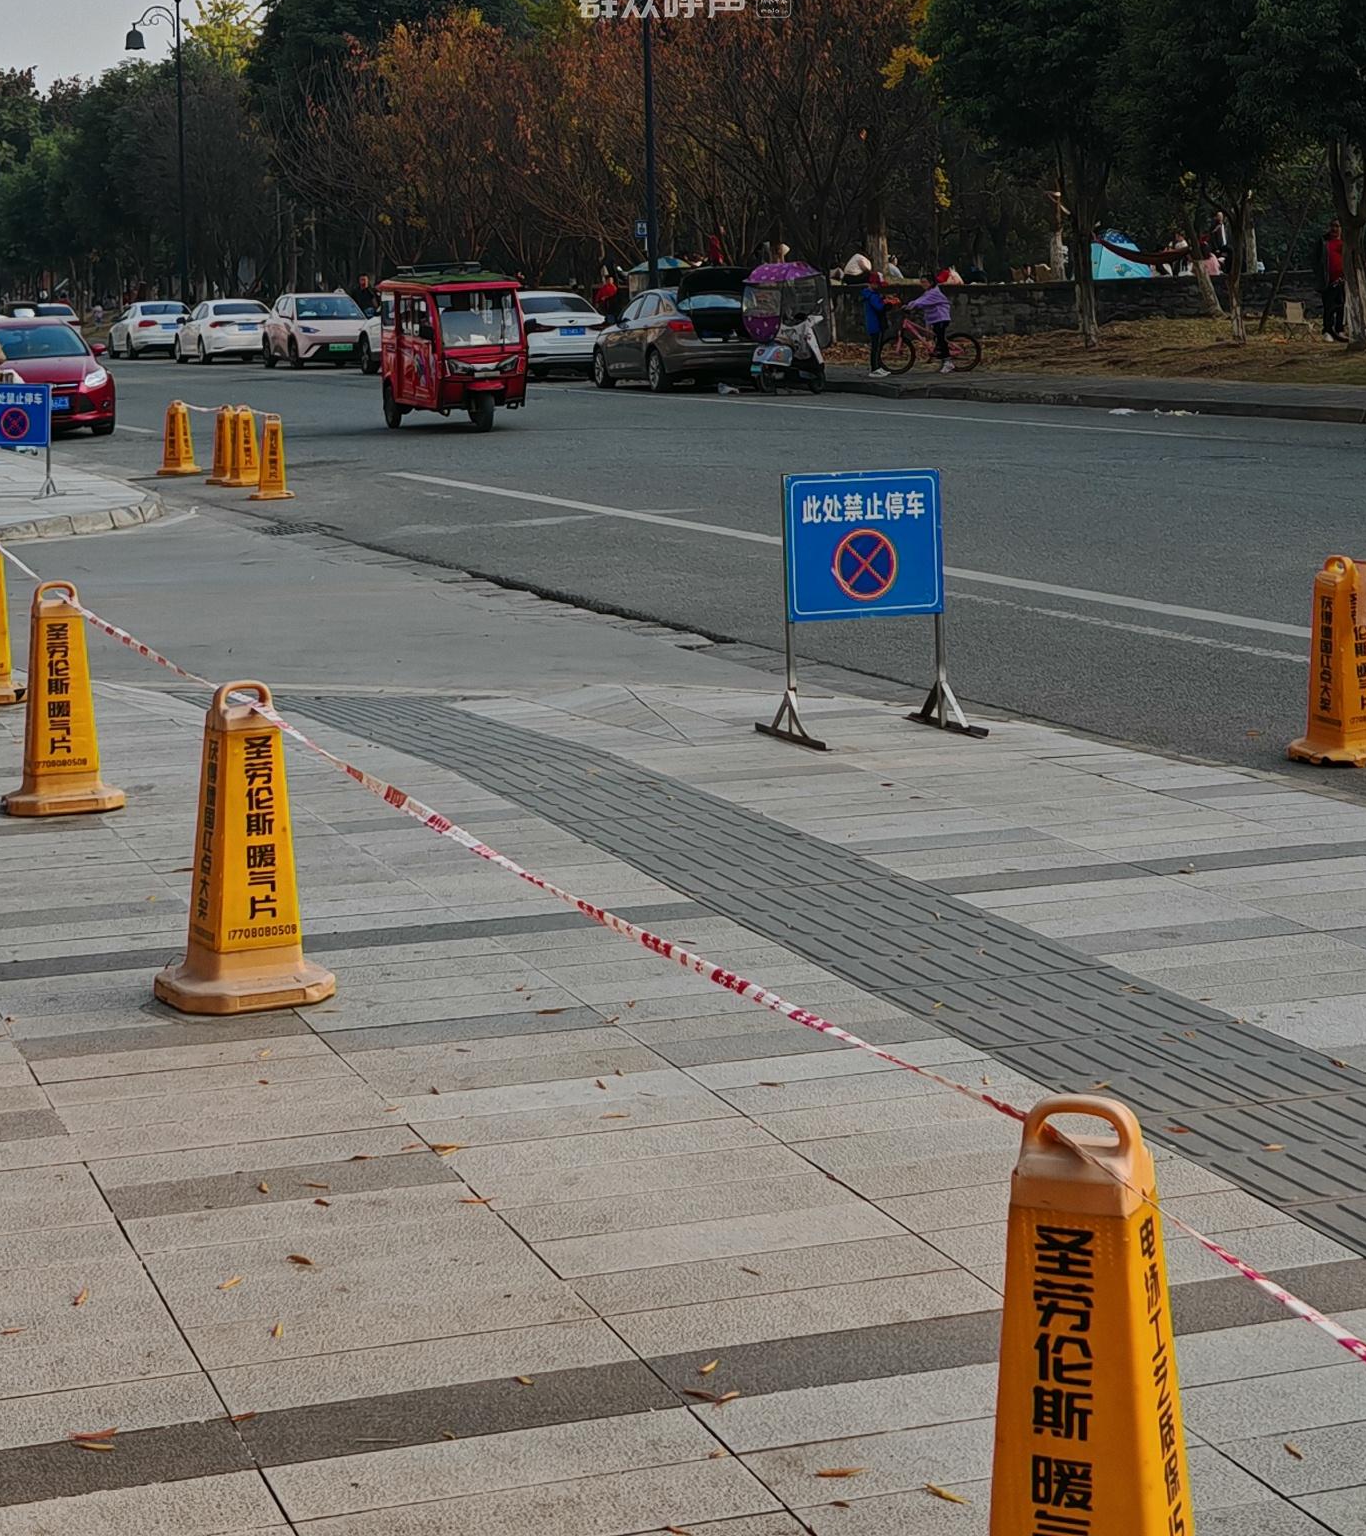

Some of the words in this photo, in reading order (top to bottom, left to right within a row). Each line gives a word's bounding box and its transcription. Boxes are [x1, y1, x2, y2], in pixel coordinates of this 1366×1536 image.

[802, 490, 925, 524] 此处禁止停车
[46, 622, 70, 695] 圣劳伦斯
[47, 700, 71, 755] 暖气片
[243, 735, 274, 837] 圣劳伦斯
[246, 843, 277, 920] 暖气片
[227, 924, 298, 942] 17708080508
[1032, 1224, 1095, 1442] 圣劳伦斯
